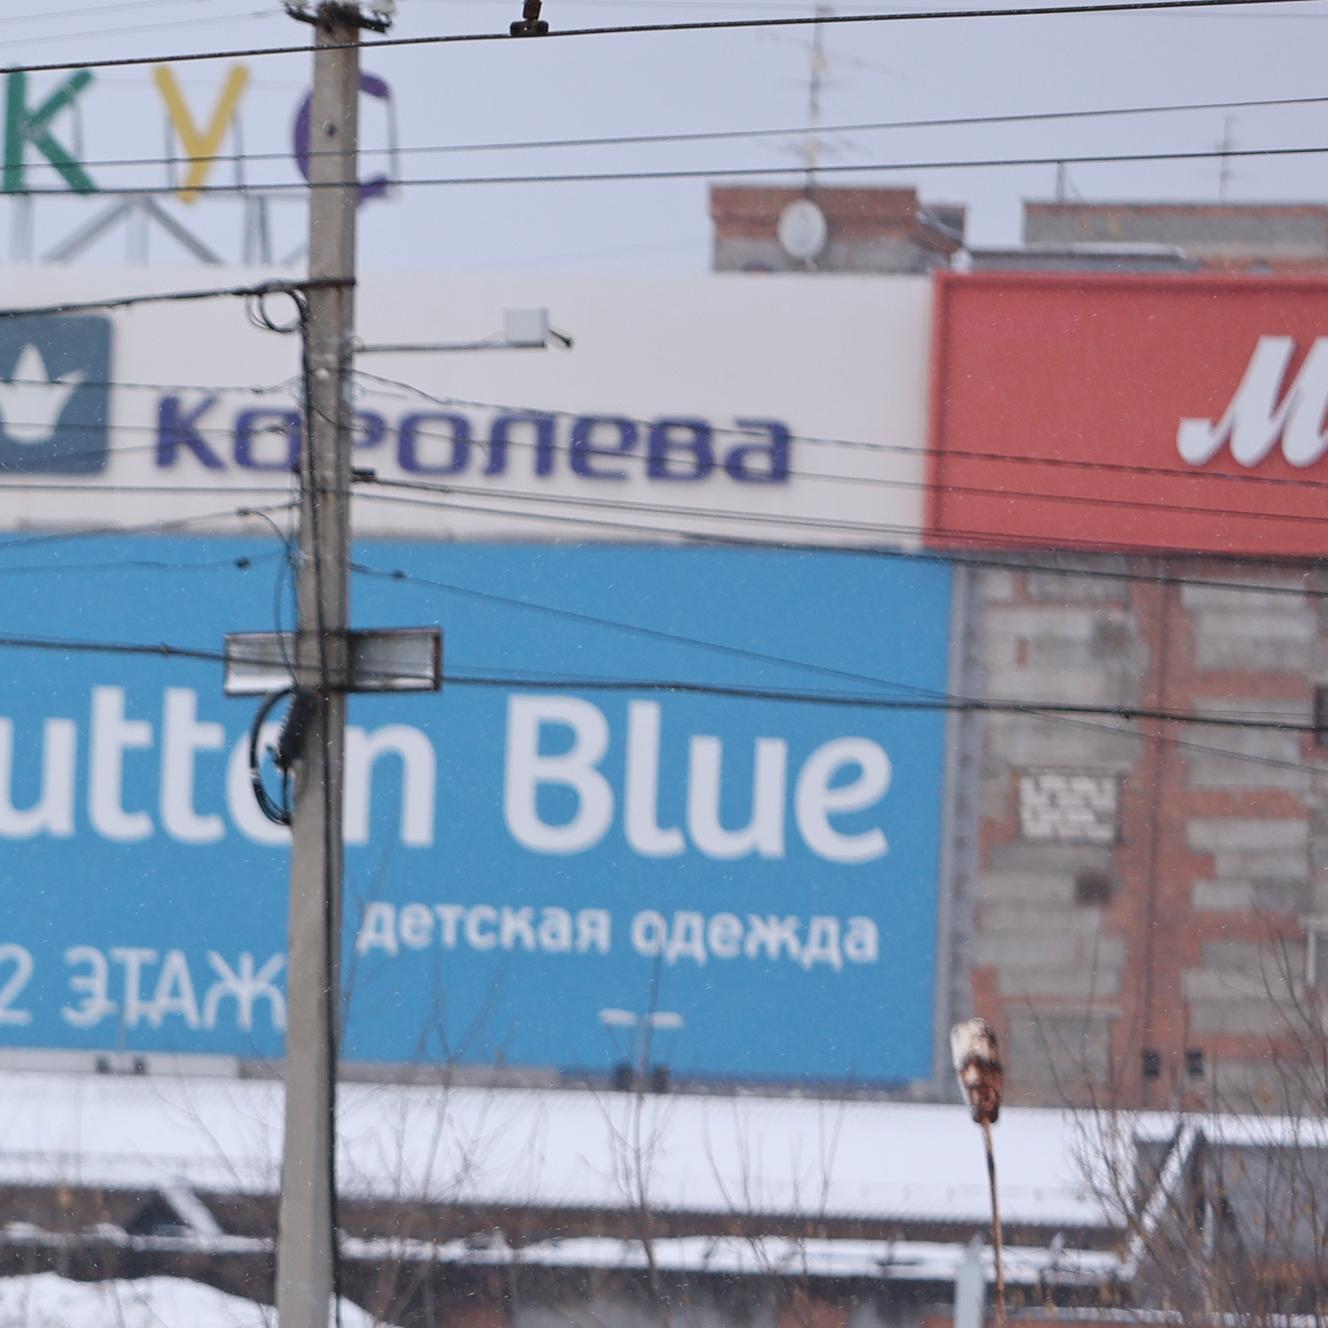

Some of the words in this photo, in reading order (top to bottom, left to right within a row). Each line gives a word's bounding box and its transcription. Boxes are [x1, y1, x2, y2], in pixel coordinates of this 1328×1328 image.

[503, 693, 893, 865] Blue
[356, 901, 611, 958] детская
[631, 907, 880, 971] одежда
[61, 946, 287, 1030] ЭТАЖ
